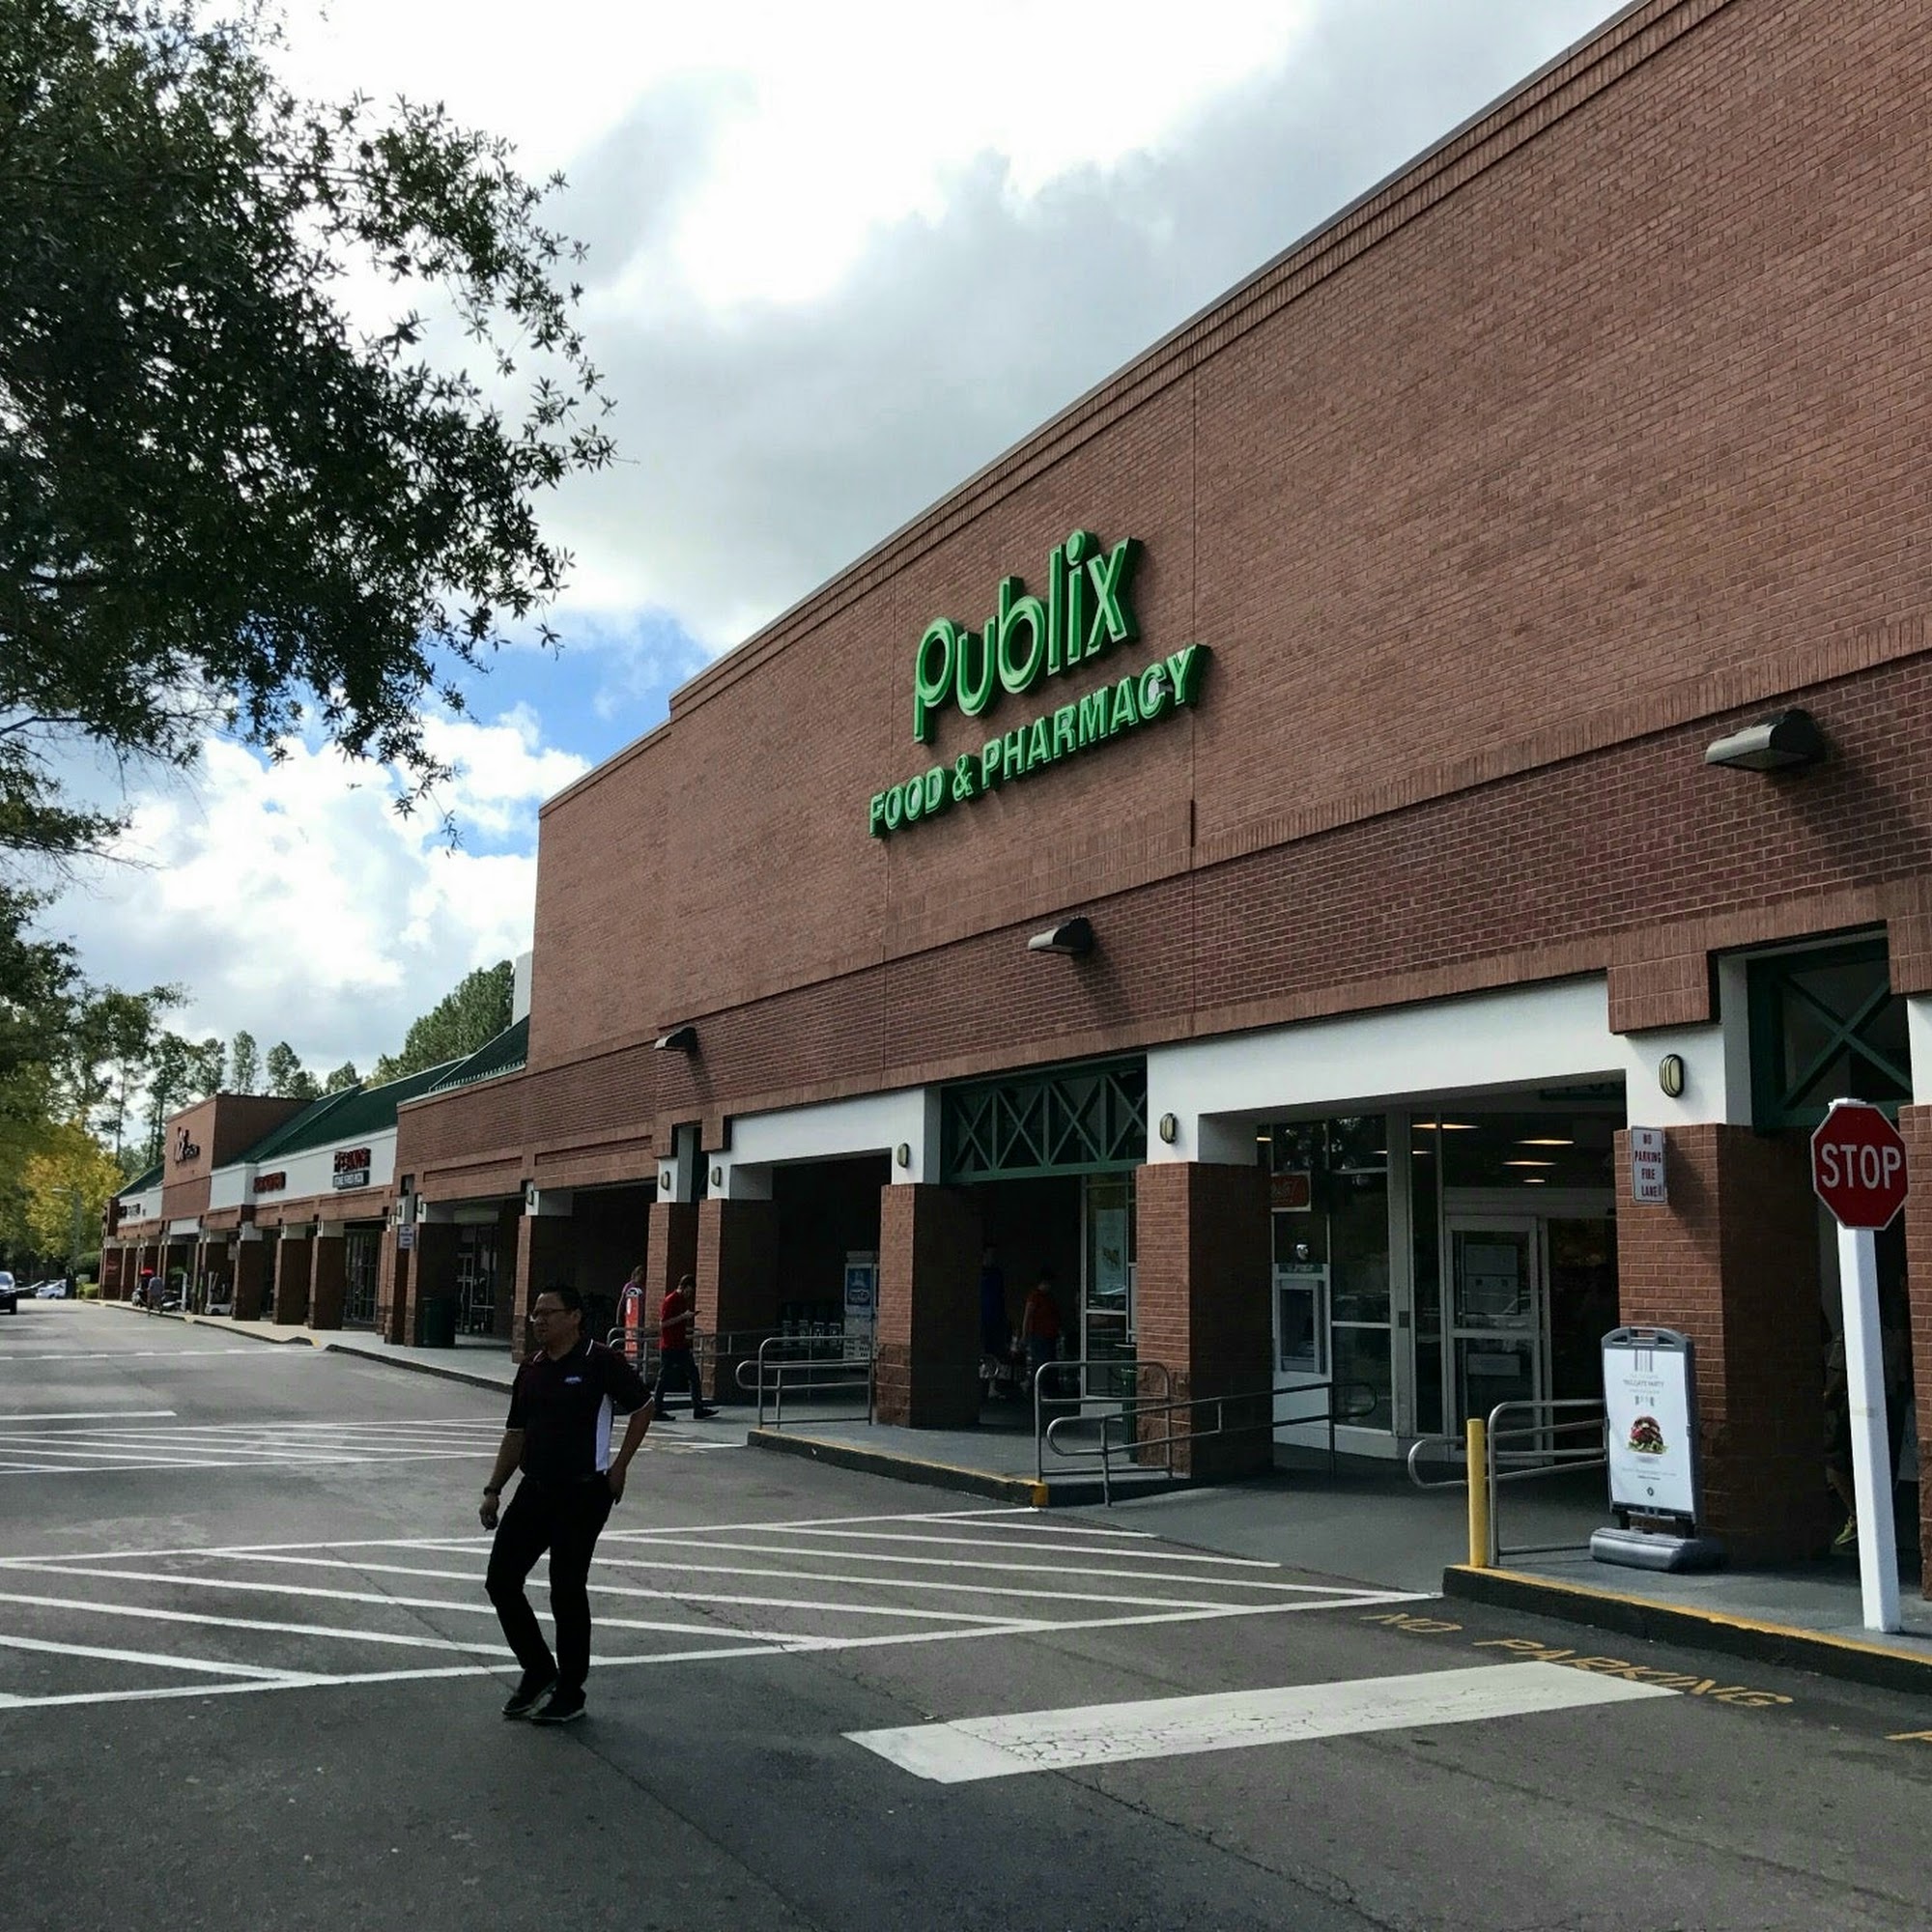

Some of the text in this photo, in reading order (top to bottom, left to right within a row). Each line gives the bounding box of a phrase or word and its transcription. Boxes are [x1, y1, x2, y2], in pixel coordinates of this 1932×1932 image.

[868, 643, 1207, 838] FOOD & PHARMACY
[1643, 1133, 1652, 1145] NO
[1635, 1150, 1662, 1163] PARKING
[1821, 1143, 1901, 1190] STOP
[1641, 1168, 1656, 1180] FIRE
[1359, 1612, 1794, 1707] NO PARKING
